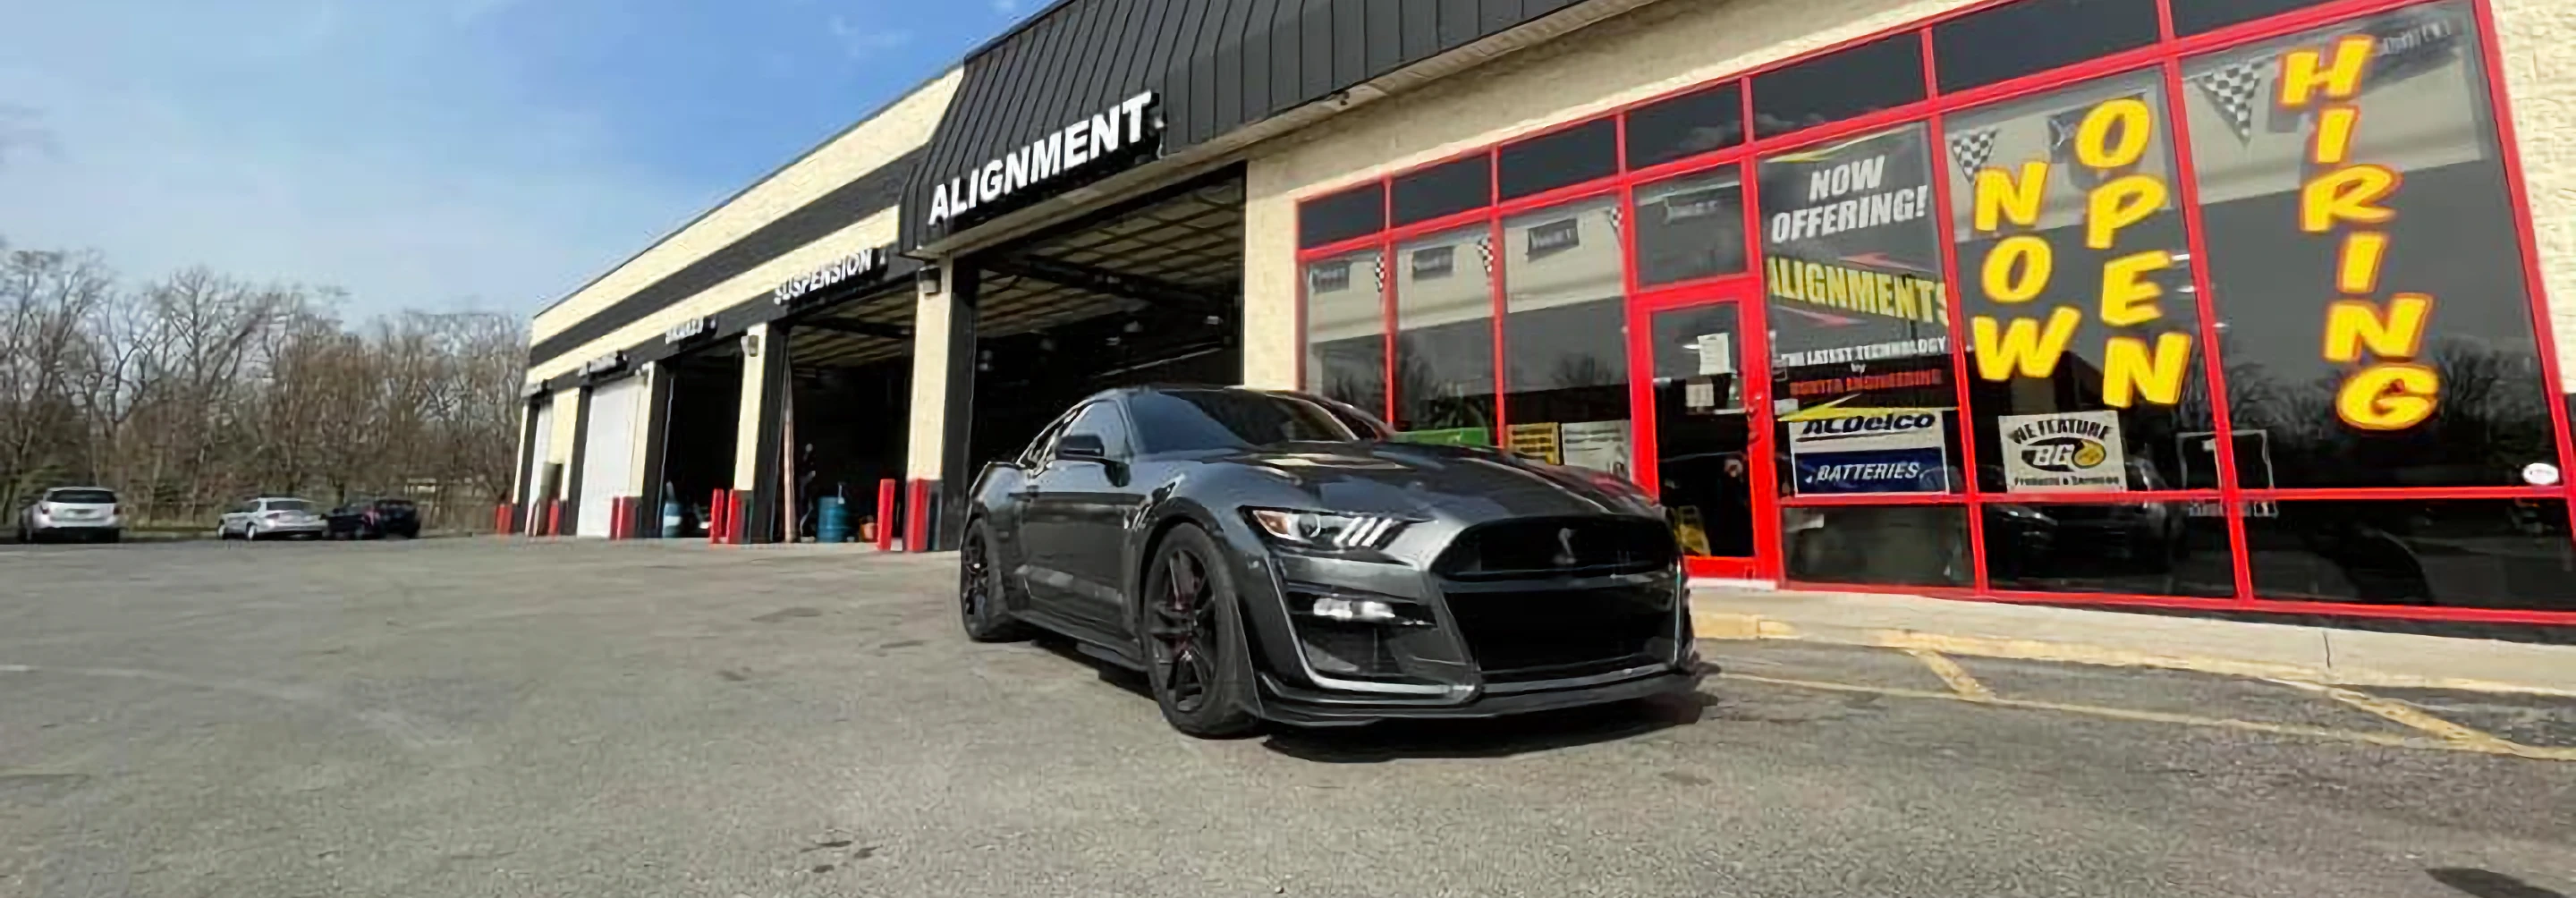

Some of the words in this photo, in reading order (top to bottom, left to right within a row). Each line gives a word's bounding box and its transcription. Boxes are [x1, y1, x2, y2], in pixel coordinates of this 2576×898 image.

[928, 90, 1153, 225] ALIGNMENT
[1809, 155, 1885, 203] NOW
[1771, 185, 1928, 244] OFFERING!
[2279, 34, 2440, 433] HIRING
[774, 248, 873, 305] SUSPENSION
[1971, 161, 2082, 382] NOW
[2075, 97, 2192, 409] OPEN
[1767, 256, 1949, 326] ALIGNMENTS
[1816, 462, 1920, 482] BATTERIES
